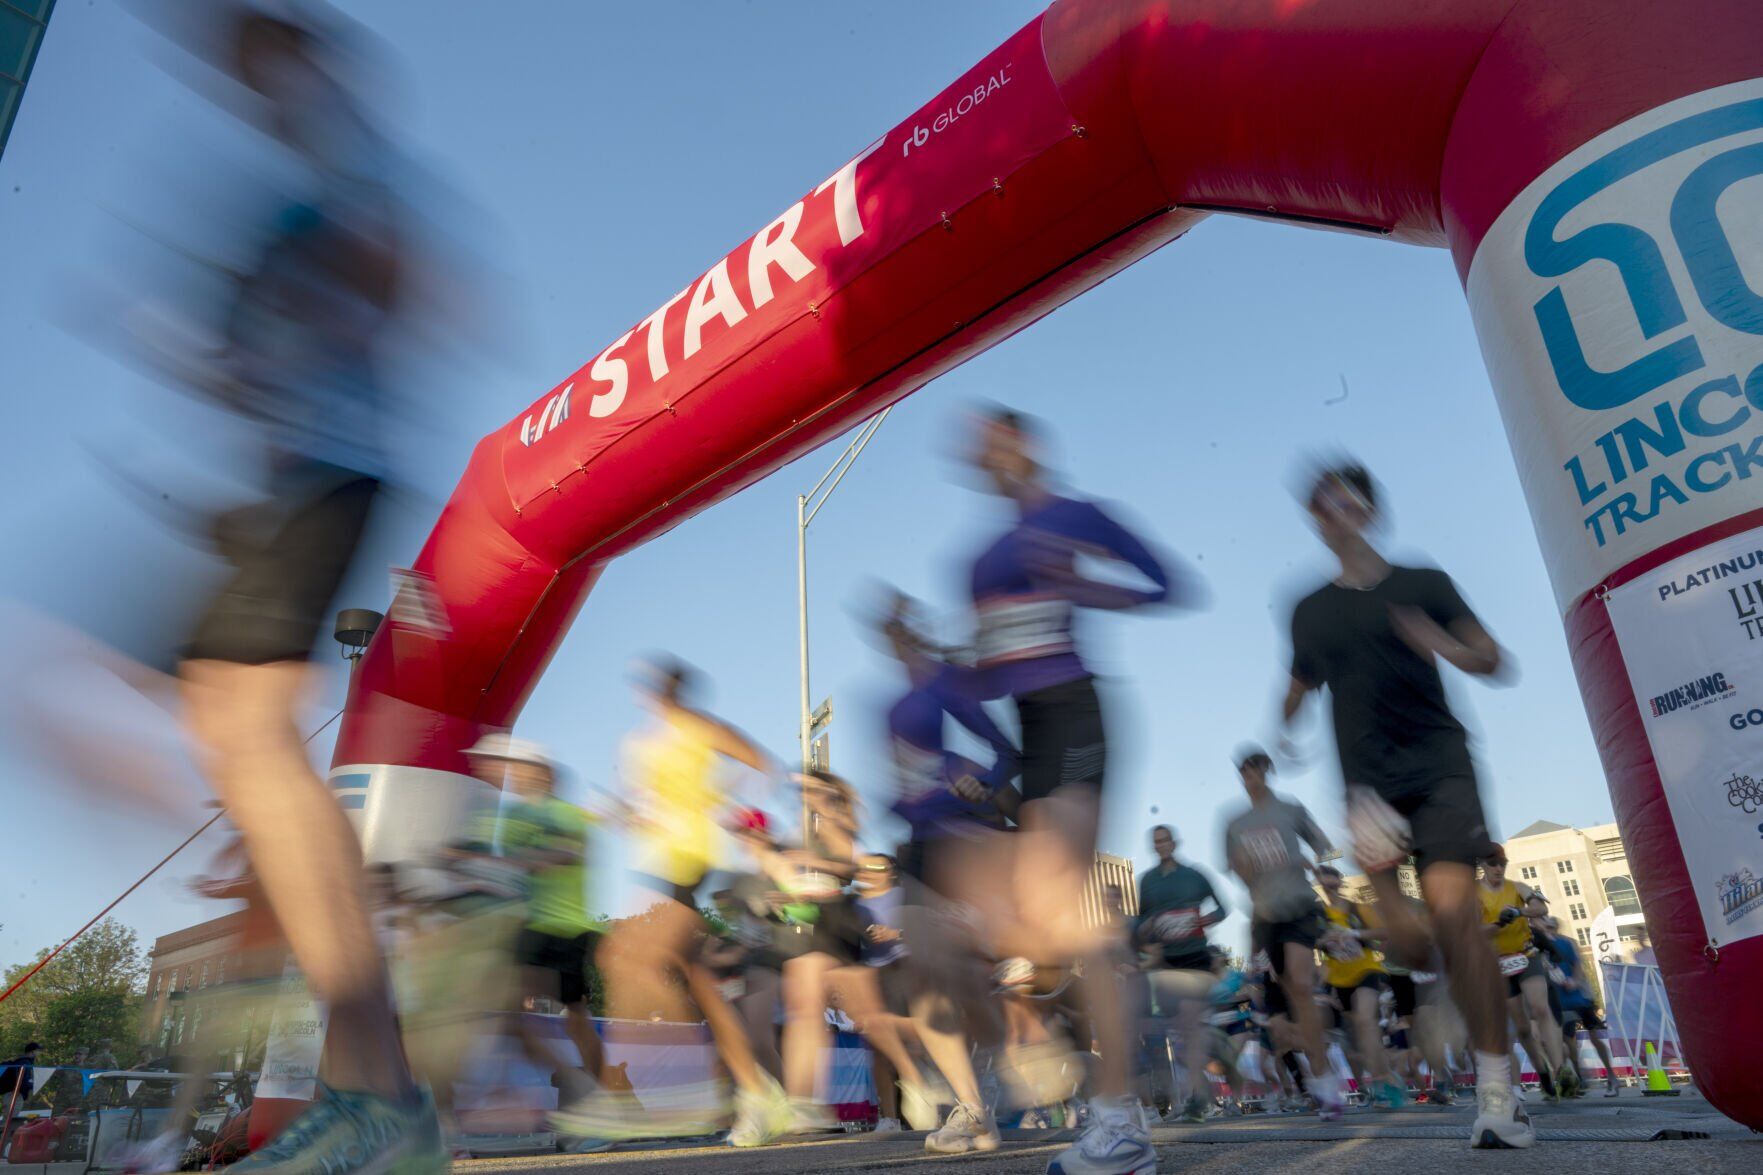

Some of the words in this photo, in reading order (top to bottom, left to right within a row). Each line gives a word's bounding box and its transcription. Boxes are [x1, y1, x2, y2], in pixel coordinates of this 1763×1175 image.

[903, 125, 929, 158] rb
[933, 69, 1012, 133] GLOBAL
[589, 134, 888, 418] START
[1563, 361, 1763, 506] LINC
[1584, 436, 1763, 547] TRACK
[1729, 709, 1763, 730] GO
[1723, 773, 1751, 793] The
[1728, 778, 1763, 806] Cook
[1399, 872, 1410, 880] NO
